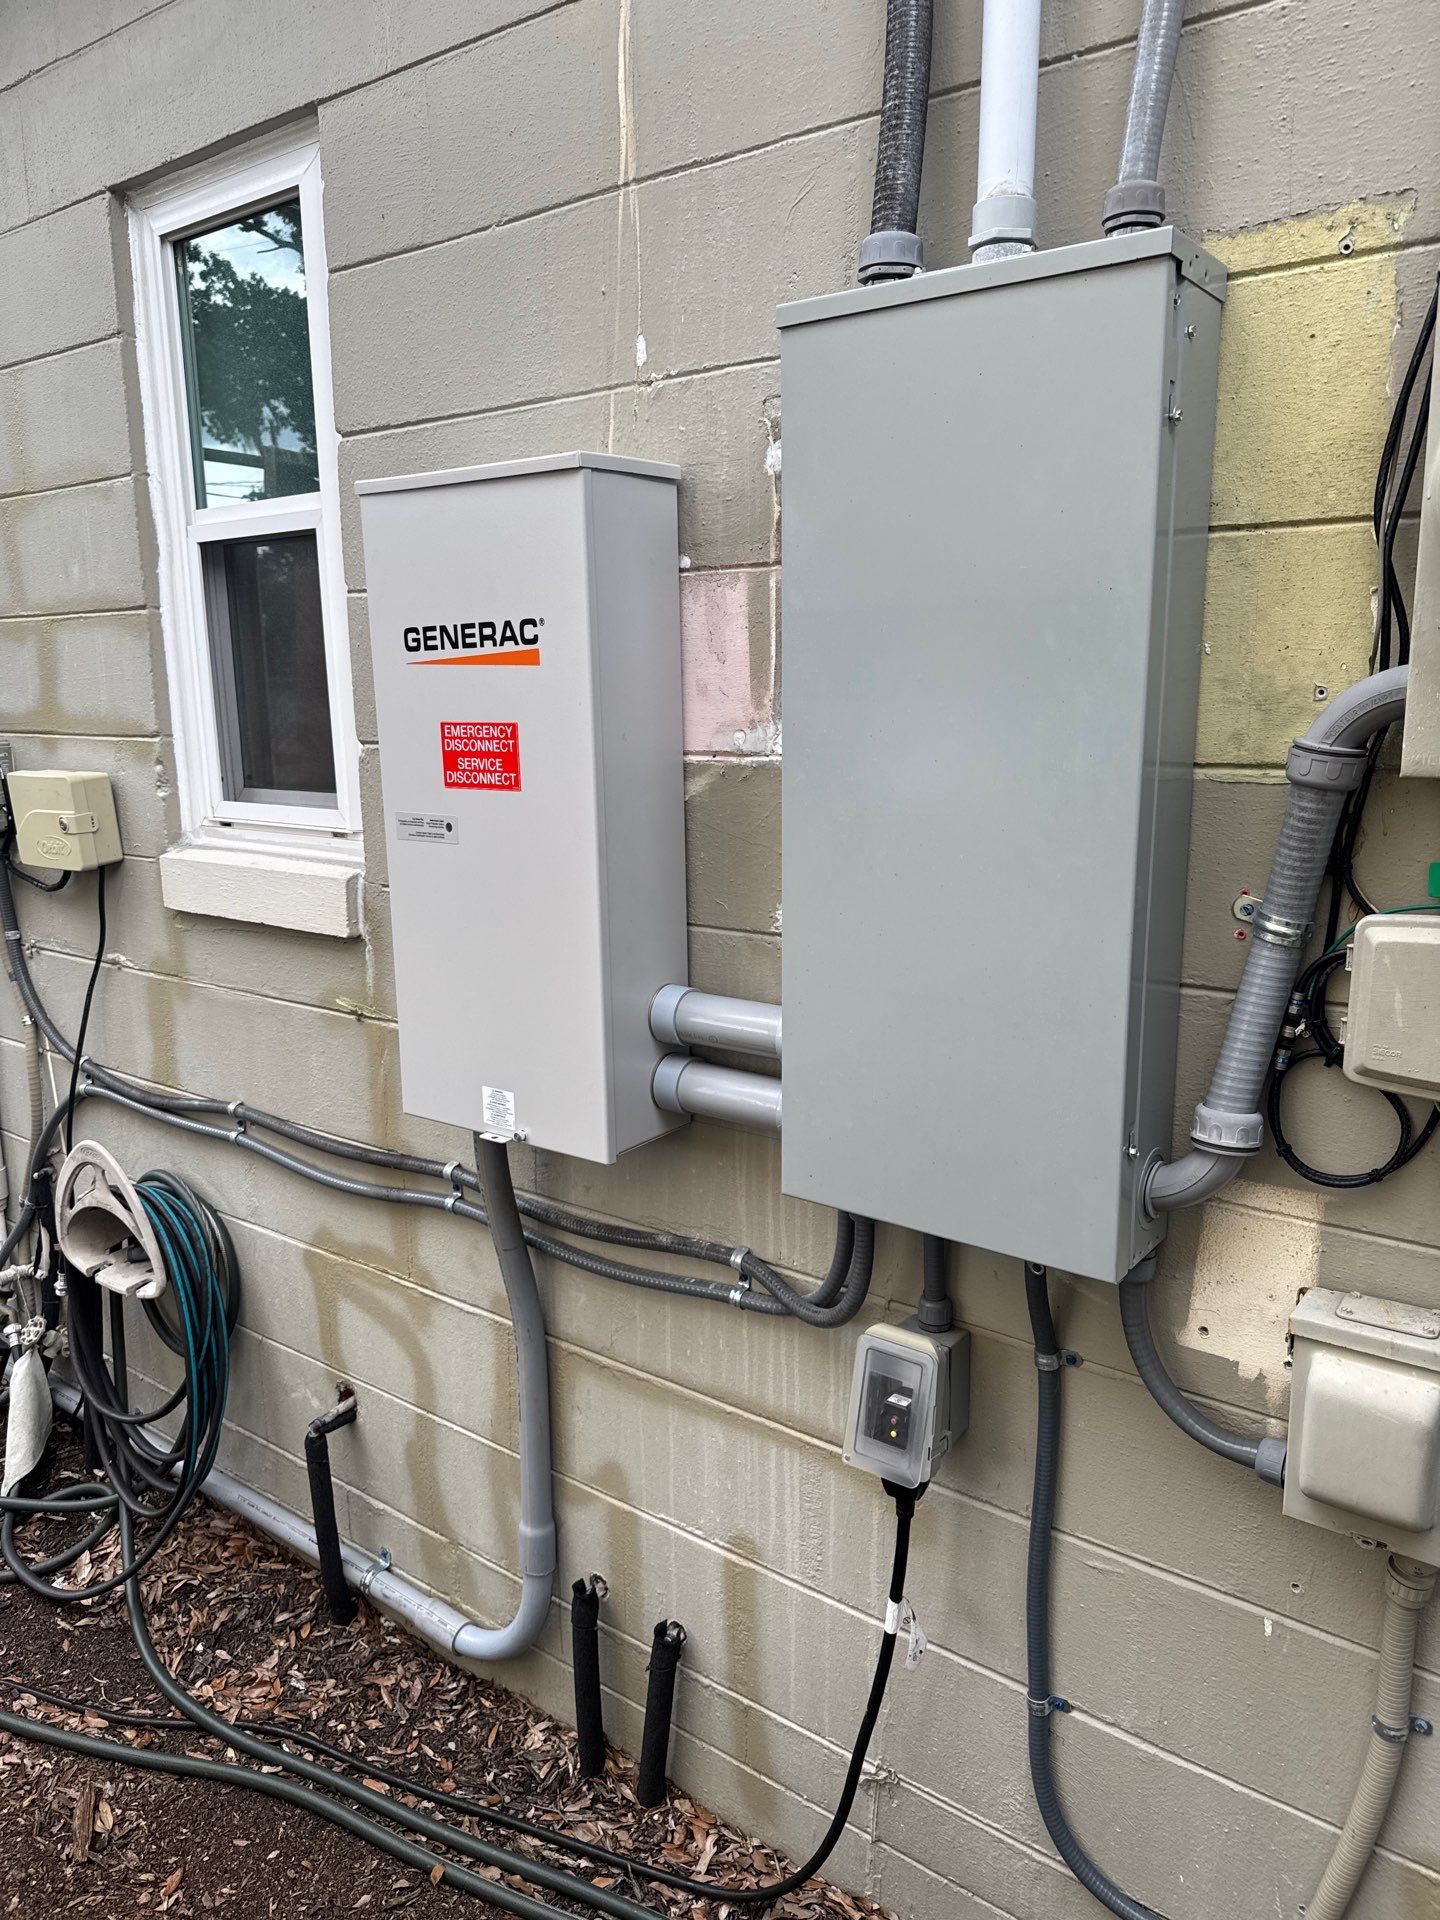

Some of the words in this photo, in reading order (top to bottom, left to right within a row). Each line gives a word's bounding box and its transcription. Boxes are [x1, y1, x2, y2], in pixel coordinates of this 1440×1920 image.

[444, 724, 513, 738] EMERGENCY
[444, 738, 515, 753] DISCONNECT
[457, 757, 504, 771] SERVICE
[446, 770, 517, 786] DISCONNECT
